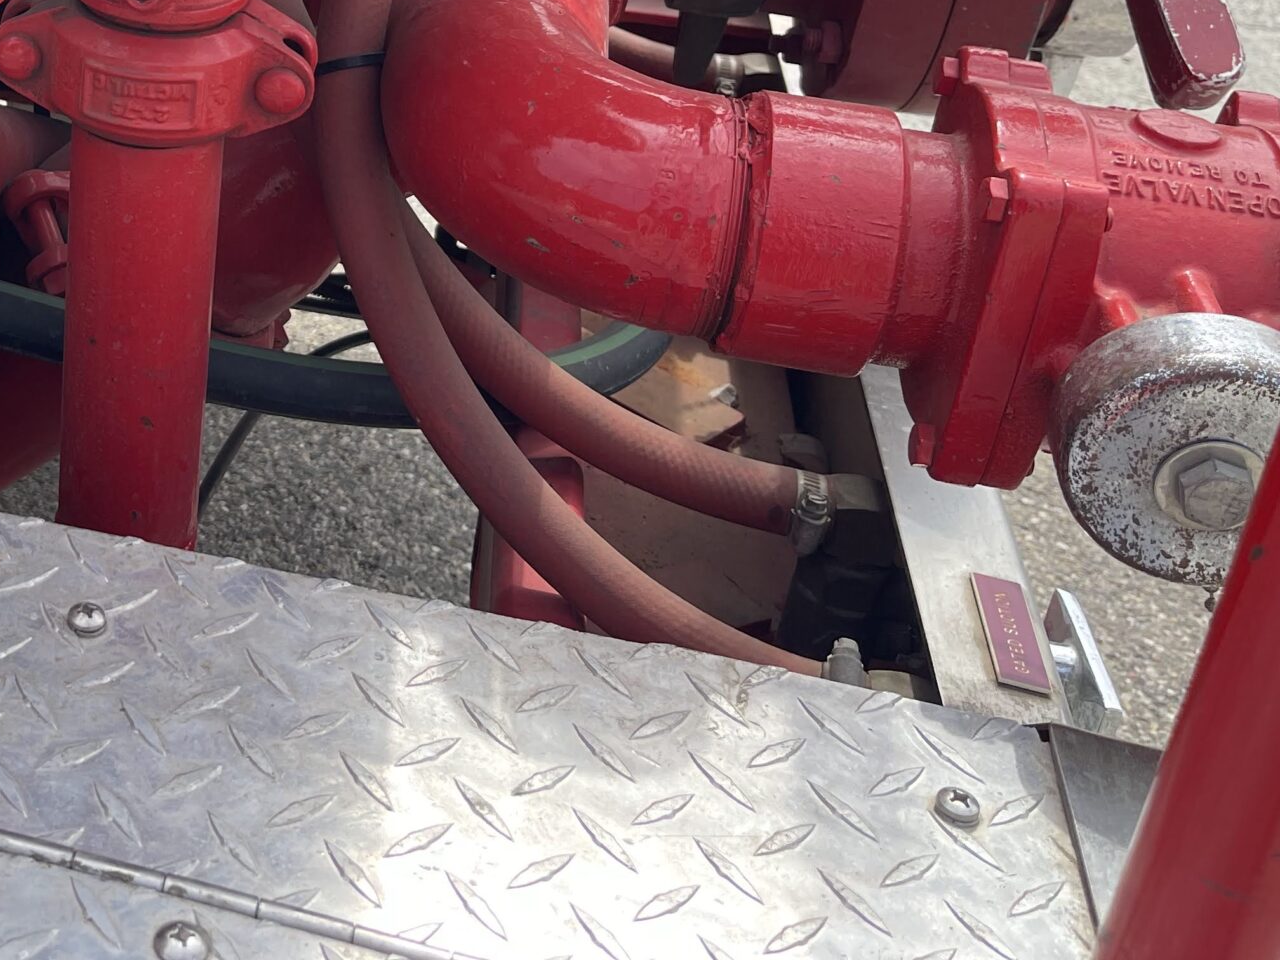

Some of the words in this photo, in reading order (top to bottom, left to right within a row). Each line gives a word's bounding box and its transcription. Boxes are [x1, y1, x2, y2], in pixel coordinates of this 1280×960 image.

[1110, 150, 1223, 182] REMOVE
[1233, 168, 1271, 189] TO
[1102, 170, 1201, 207] VALVE
[1206, 187, 1280, 219] OPEN
